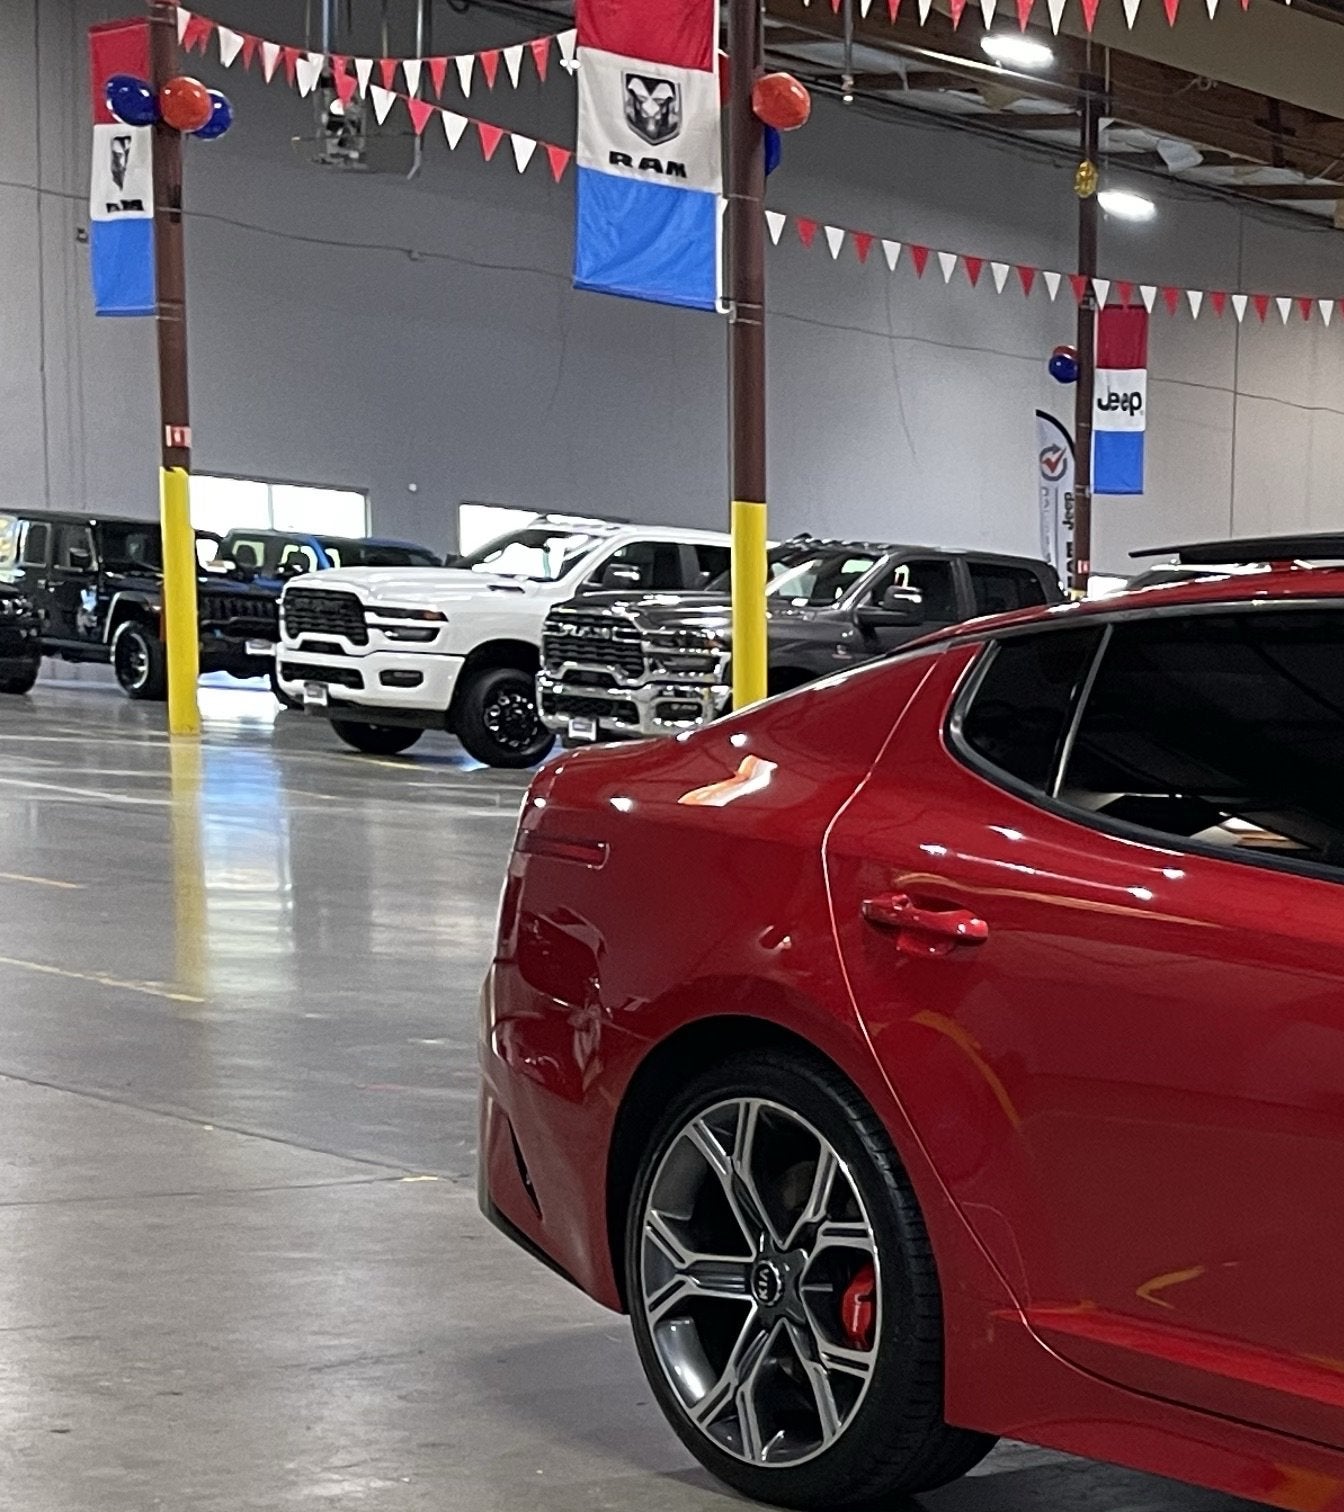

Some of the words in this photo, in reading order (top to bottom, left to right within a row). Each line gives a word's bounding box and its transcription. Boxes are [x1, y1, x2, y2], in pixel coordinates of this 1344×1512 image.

[608, 150, 688, 179] RAM
[1097, 386, 1143, 417] Jeep
[758, 1268, 769, 1300] KIA
